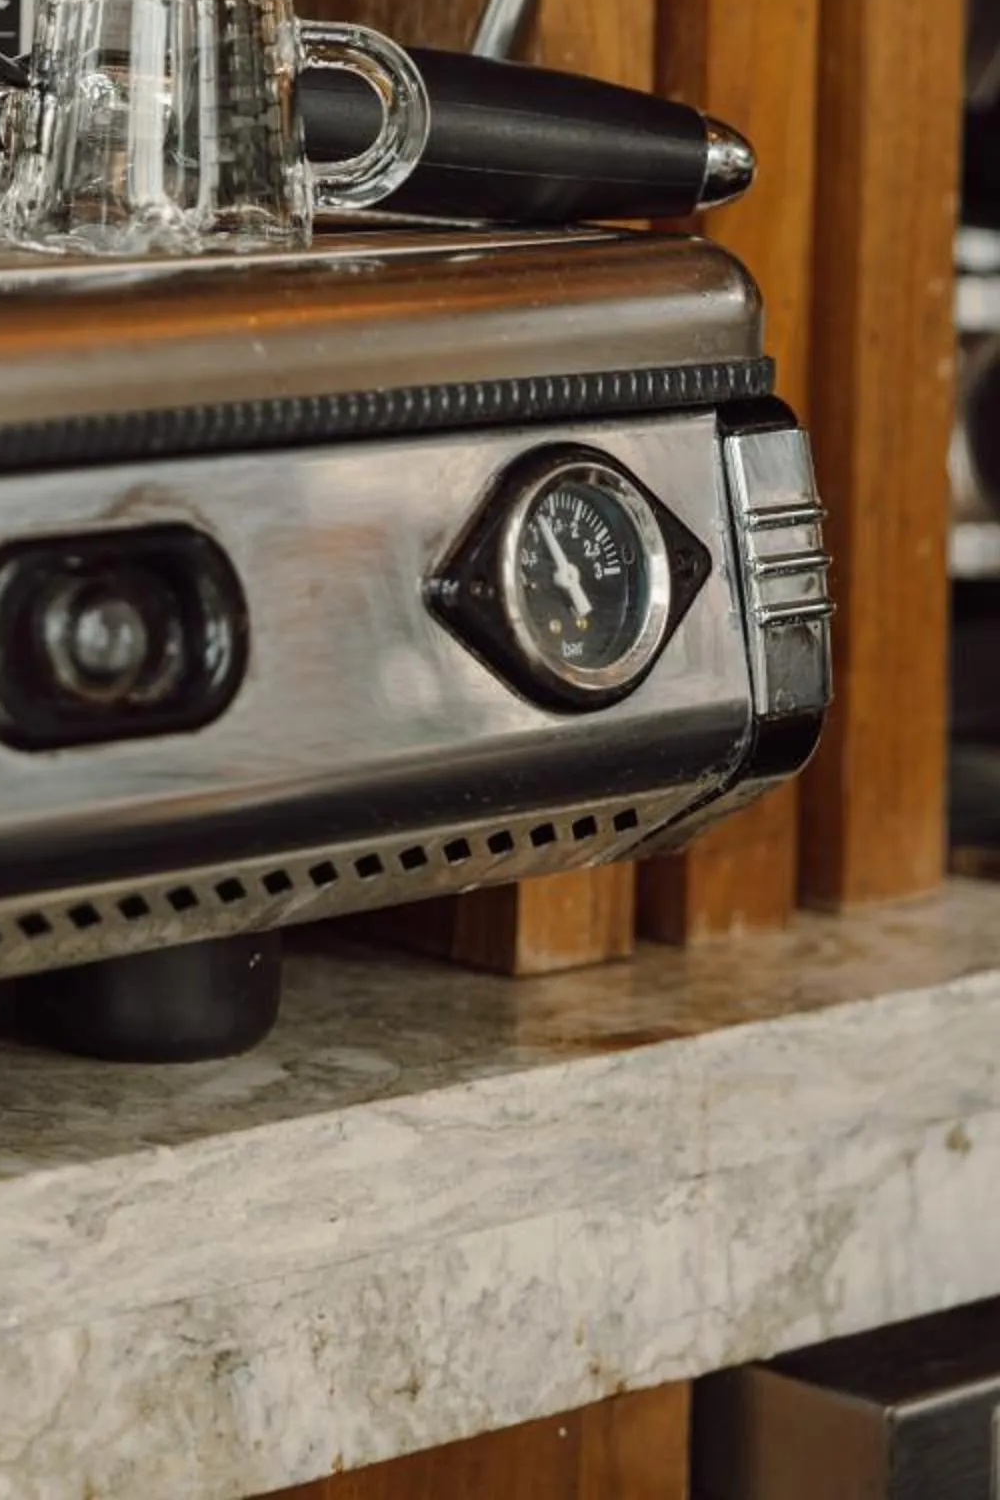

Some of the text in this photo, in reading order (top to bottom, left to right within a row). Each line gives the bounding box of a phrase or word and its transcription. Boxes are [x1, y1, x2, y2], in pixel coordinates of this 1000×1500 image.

[570, 521, 580, 539] 2
[593, 561, 603, 580] 3
[562, 640, 584, 658] bar
